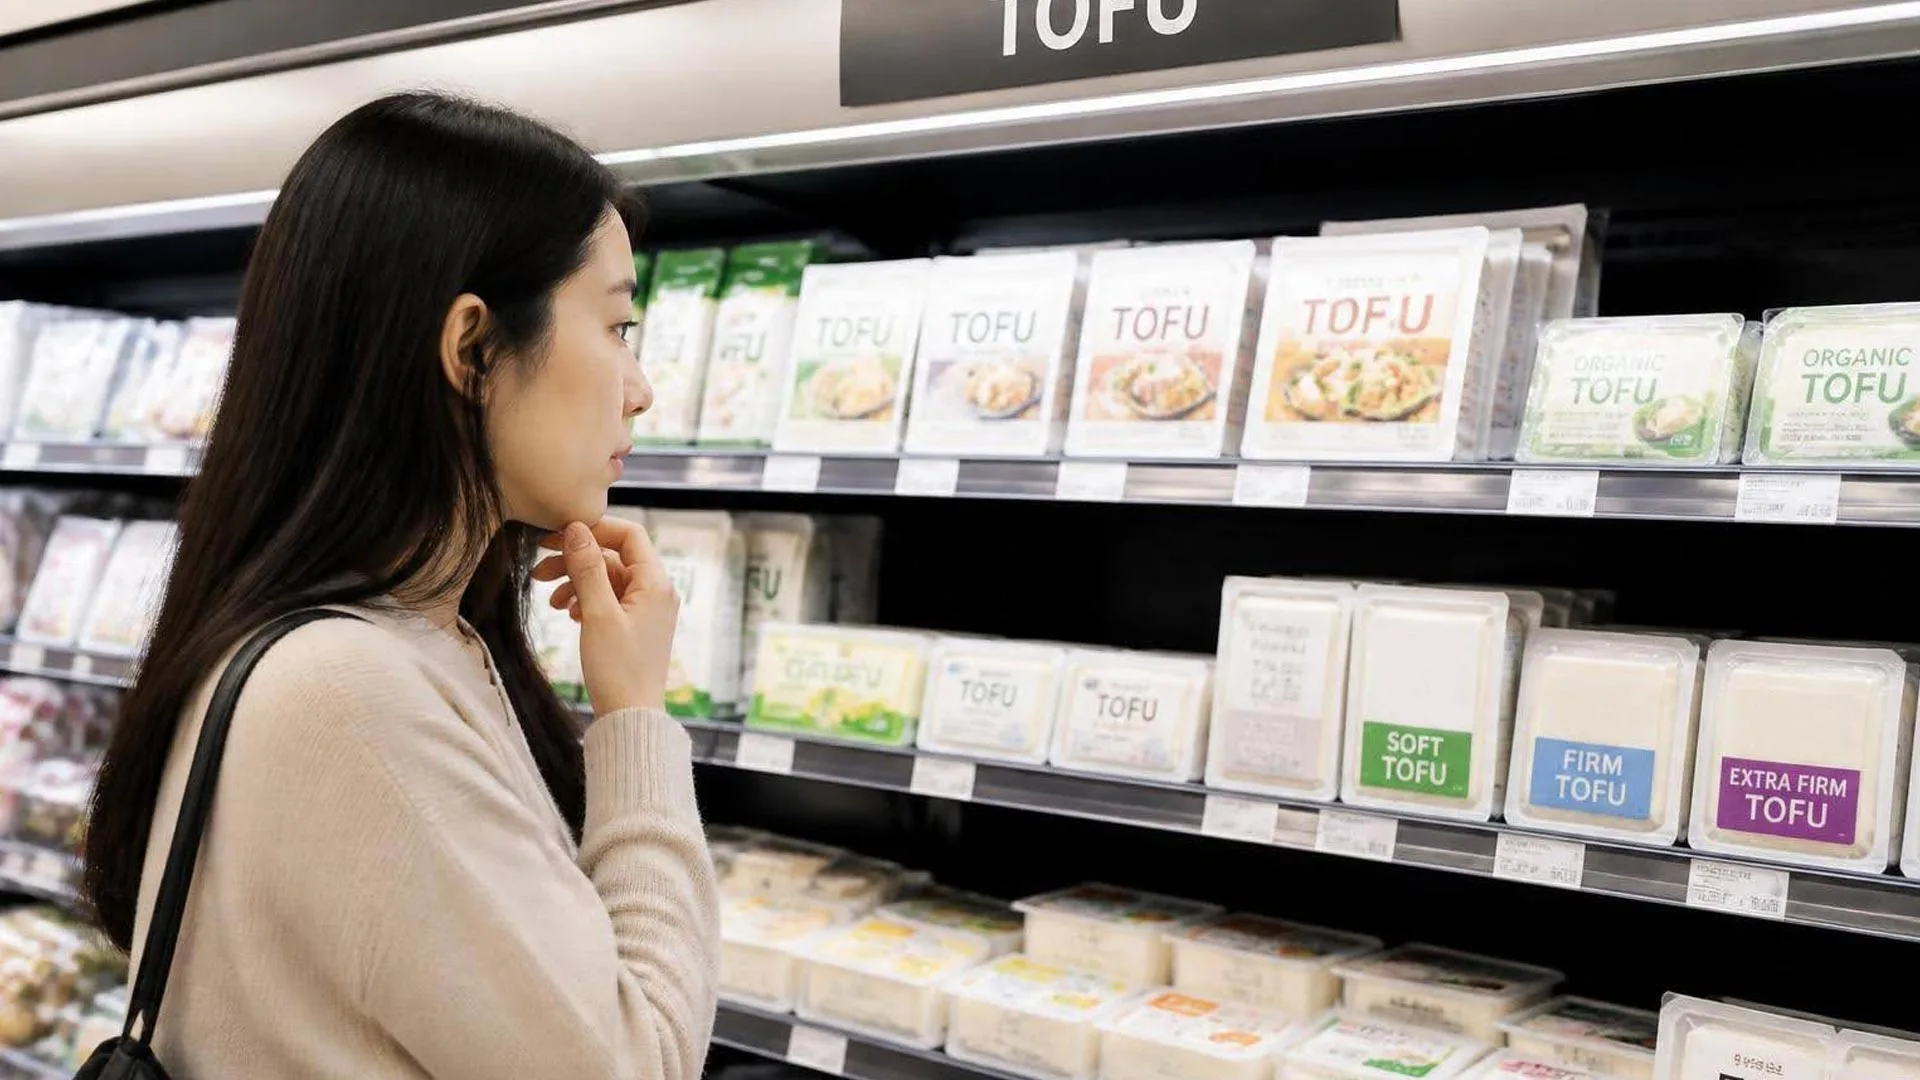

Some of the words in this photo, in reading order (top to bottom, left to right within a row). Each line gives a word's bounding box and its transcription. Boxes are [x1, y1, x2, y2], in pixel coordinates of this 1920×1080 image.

[816, 315, 894, 347] TOFU
[950, 310, 1037, 344] TOFU
[1112, 305, 1210, 341] TOFU
[1573, 353, 1666, 373] ORGANIC
[1803, 347, 1913, 367] ORGANIC
[1571, 377, 1658, 405] TOFU
[1801, 372, 1908, 404] TOFU
[960, 680, 1018, 708] TOFU
[1098, 694, 1159, 722] TOFU
[1386, 731, 1445, 758] SOFT
[1381, 755, 1448, 786] TOFU
[1563, 749, 1624, 777] FIRM
[1555, 774, 1627, 806] TOFU
[1729, 767, 1791, 793] EXTRA
[1797, 773, 1848, 798] FIRM
[1745, 793, 1829, 829] TOFU
